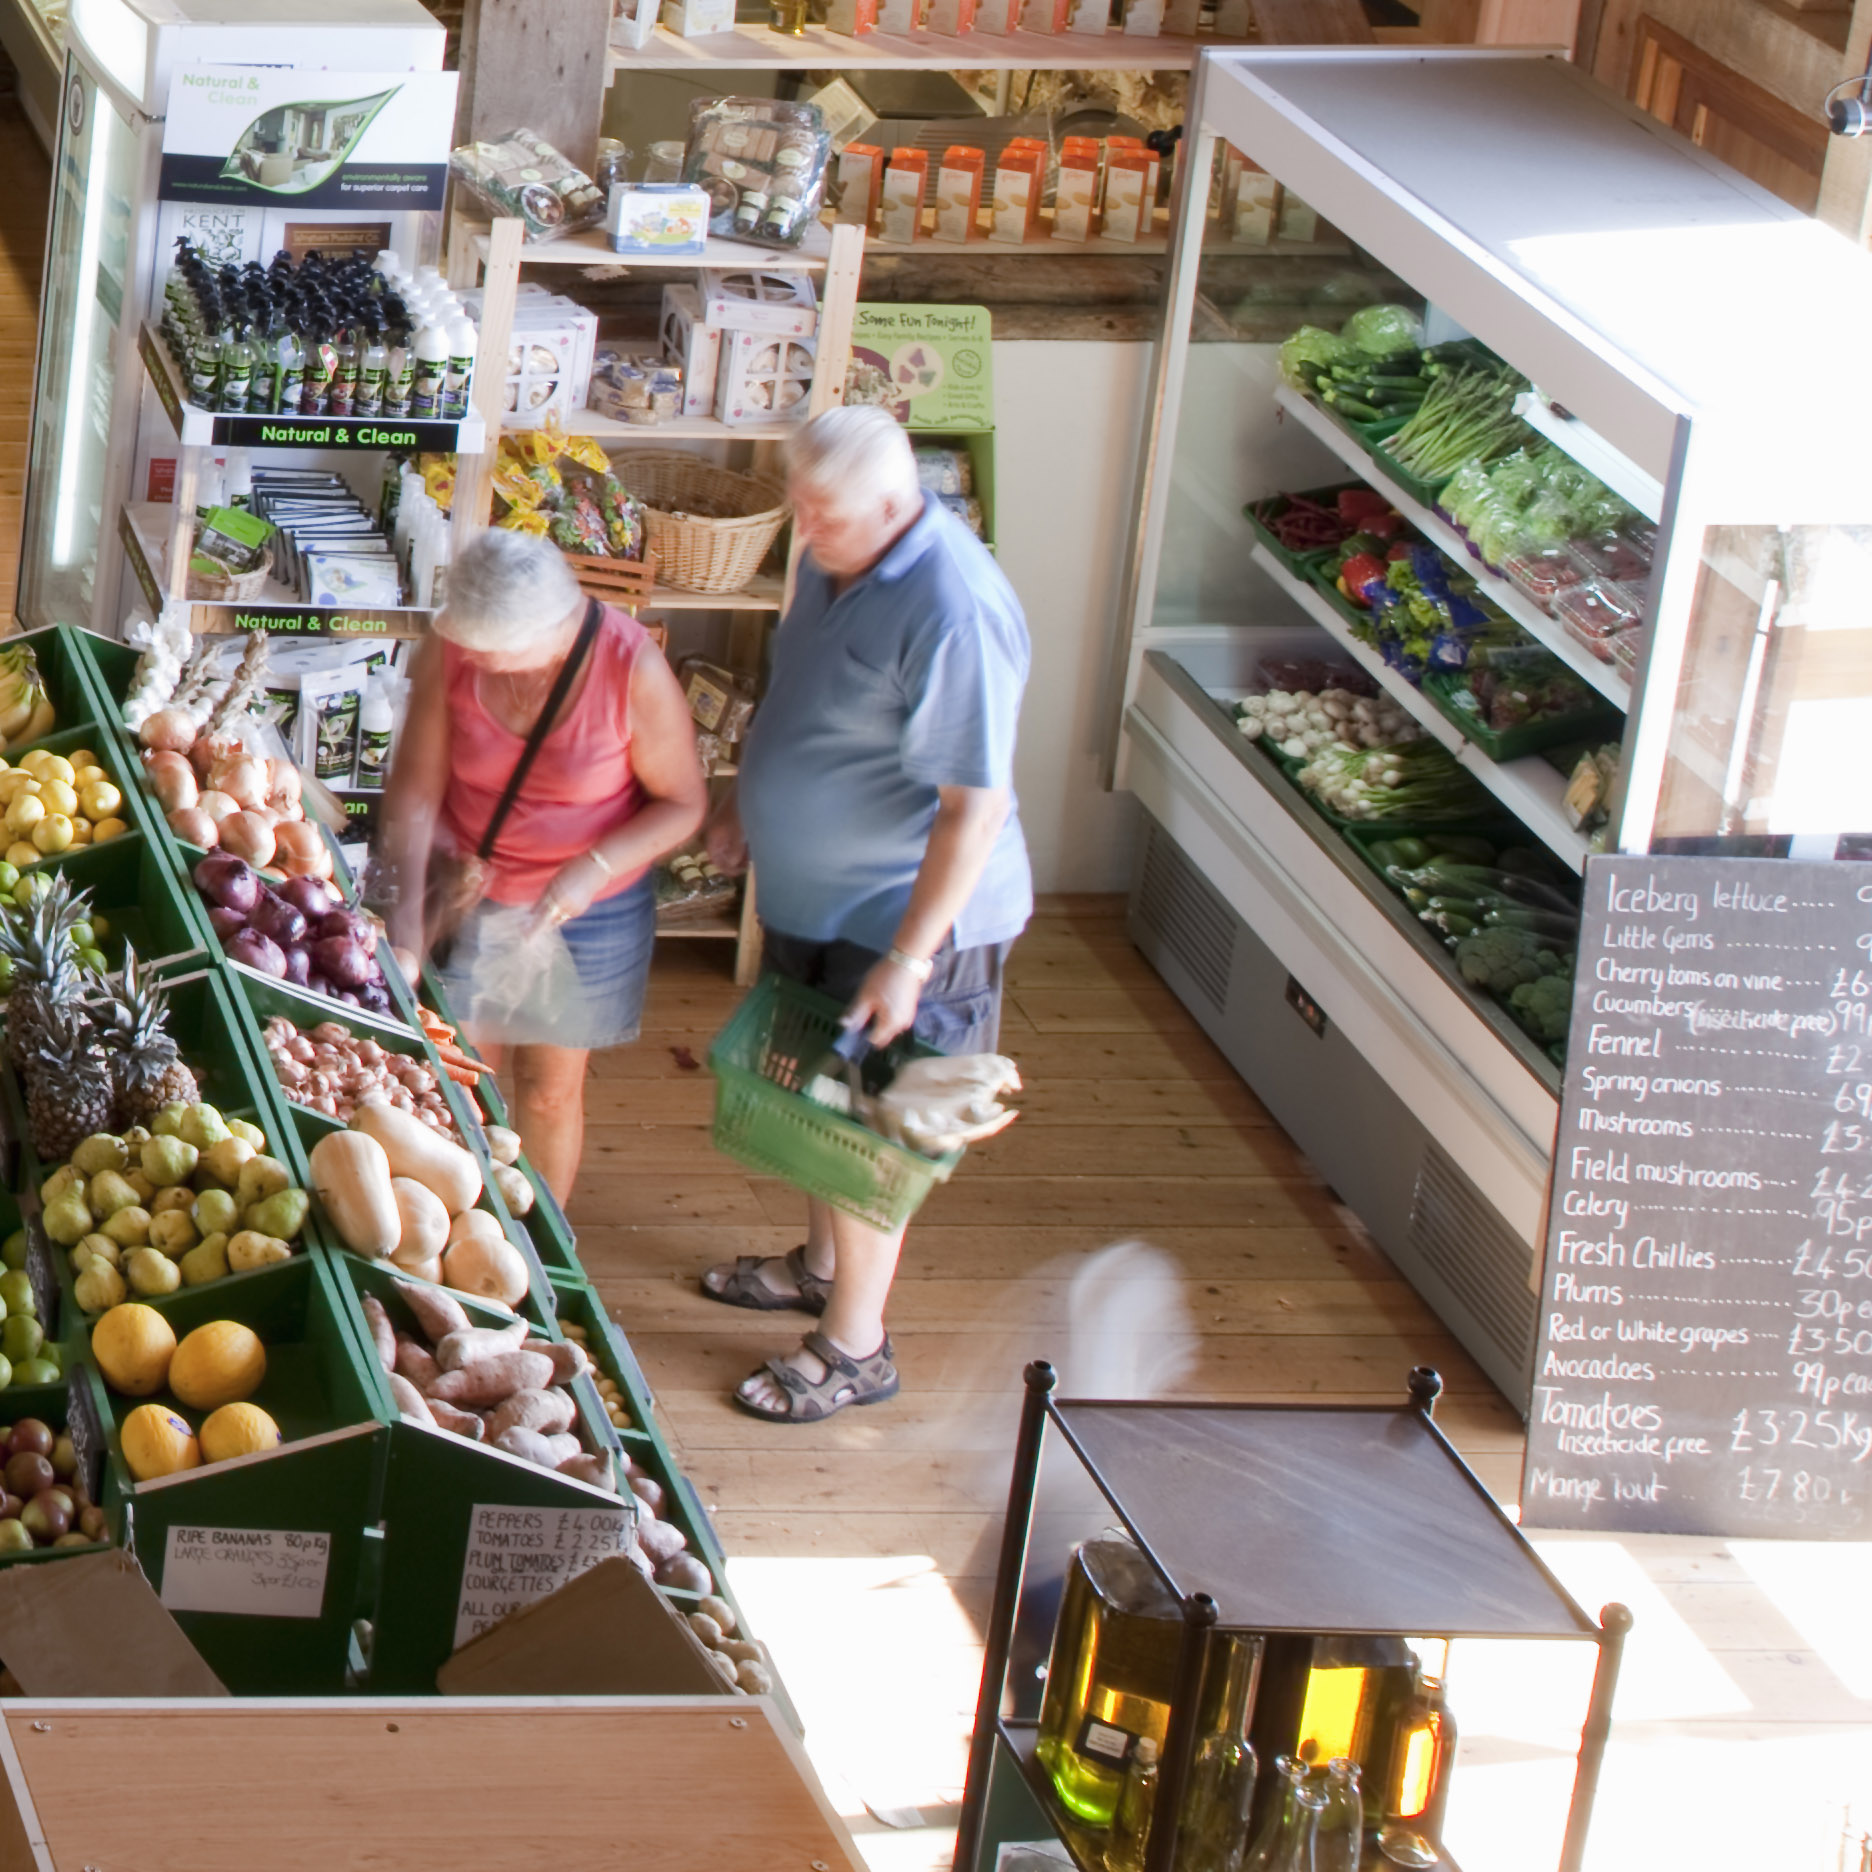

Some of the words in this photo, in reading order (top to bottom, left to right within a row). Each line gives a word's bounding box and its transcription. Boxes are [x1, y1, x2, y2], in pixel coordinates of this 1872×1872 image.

[182, 74, 243, 89] Natural
[208, 92, 257, 105] Clean
[183, 215, 245, 227] KENT
[859, 310, 895, 327] Some
[899, 313, 921, 327] Fun
[261, 426, 331, 444] Natural
[335, 429, 350, 444] &
[357, 427, 416, 445] Clean
[235, 615, 303, 631] Natural
[307, 617, 322, 632] &
[329, 616, 387, 633] Clean
[1608, 873, 1698, 922] Iceberg
[1603, 923, 1656, 948] Little
[1662, 926, 1714, 955] Gems
[1596, 957, 1663, 993] Cherry
[1667, 964, 1711, 986] toms
[1714, 971, 1738, 990] on
[1592, 990, 1692, 1016] Cucumbers
[1588, 1024, 1662, 1058] Fennel
[1582, 1066, 1648, 1103] Spring
[1651, 1078, 1721, 1097] onions
[1578, 1108, 1694, 1138] Mushrooms
[1571, 1146, 1629, 1183] Field
[1636, 1161, 1762, 1189] mushrooms
[1563, 1191, 1630, 1229] Celery
[1557, 1231, 1625, 1267] Fresh
[1633, 1236, 1716, 1270] Chillies
[1554, 1273, 1623, 1306] Plums
[1548, 1312, 1585, 1342] Red
[1590, 1323, 1612, 1341] or
[1617, 1319, 1677, 1344] White
[1679, 1326, 1750, 1353] grapes
[1543, 1350, 1655, 1382] Avocadoes
[1533, 1384, 1662, 1436] Tomatoes
[1663, 1435, 1712, 1464] free
[1530, 1464, 1605, 1512] Mange
[478, 1512, 543, 1529] PEPPERS
[176, 1529, 209, 1545] RIPE
[212, 1531, 272, 1547] BANANAS
[476, 1530, 545, 1547] TOMATOES
[468, 1550, 504, 1568] PLUM
[466, 1575, 554, 1592] COURGETTES
[462, 1600, 489, 1617] ALL
